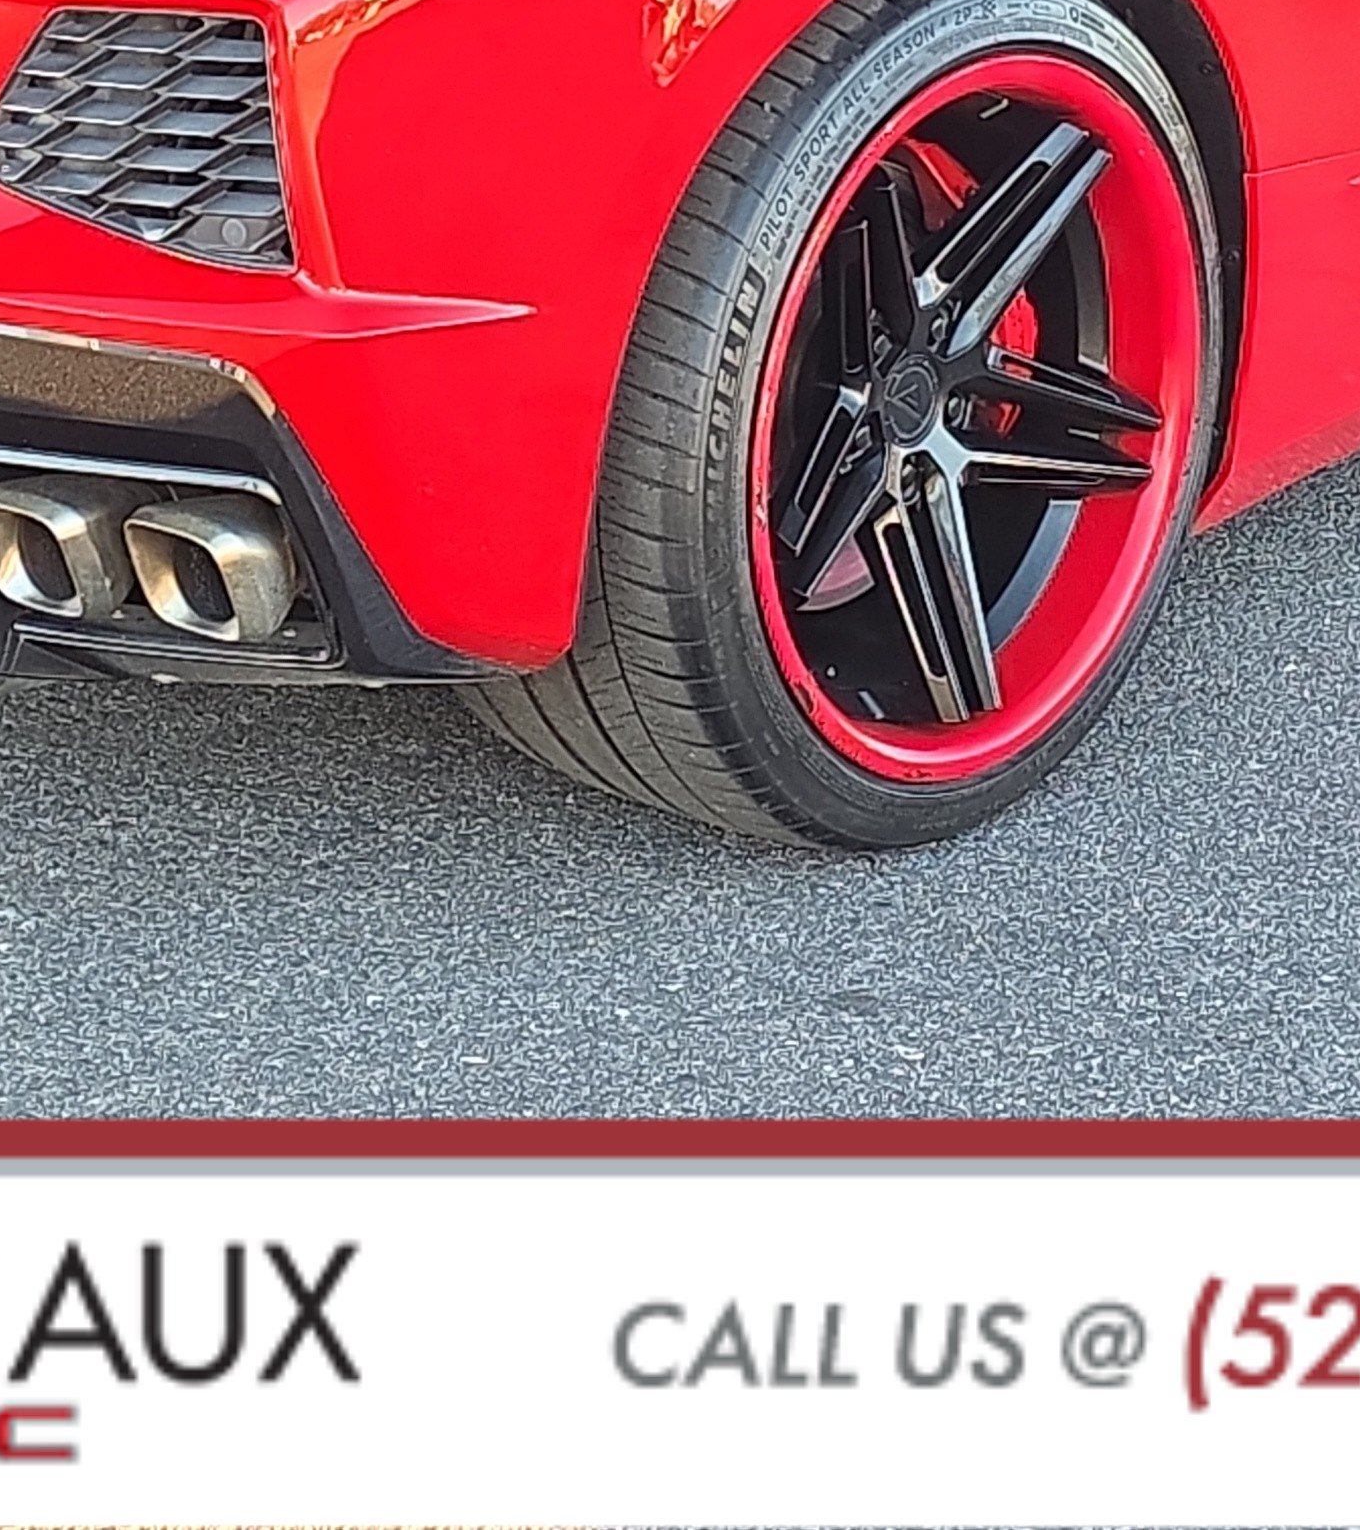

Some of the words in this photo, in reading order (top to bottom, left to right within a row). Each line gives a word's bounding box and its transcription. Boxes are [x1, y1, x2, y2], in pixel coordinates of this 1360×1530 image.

[758, 186, 796, 252] PILOT
[794, 111, 840, 183] SPORT
[843, 79, 872, 114] ALL
[873, 22, 937, 80] SEASON
